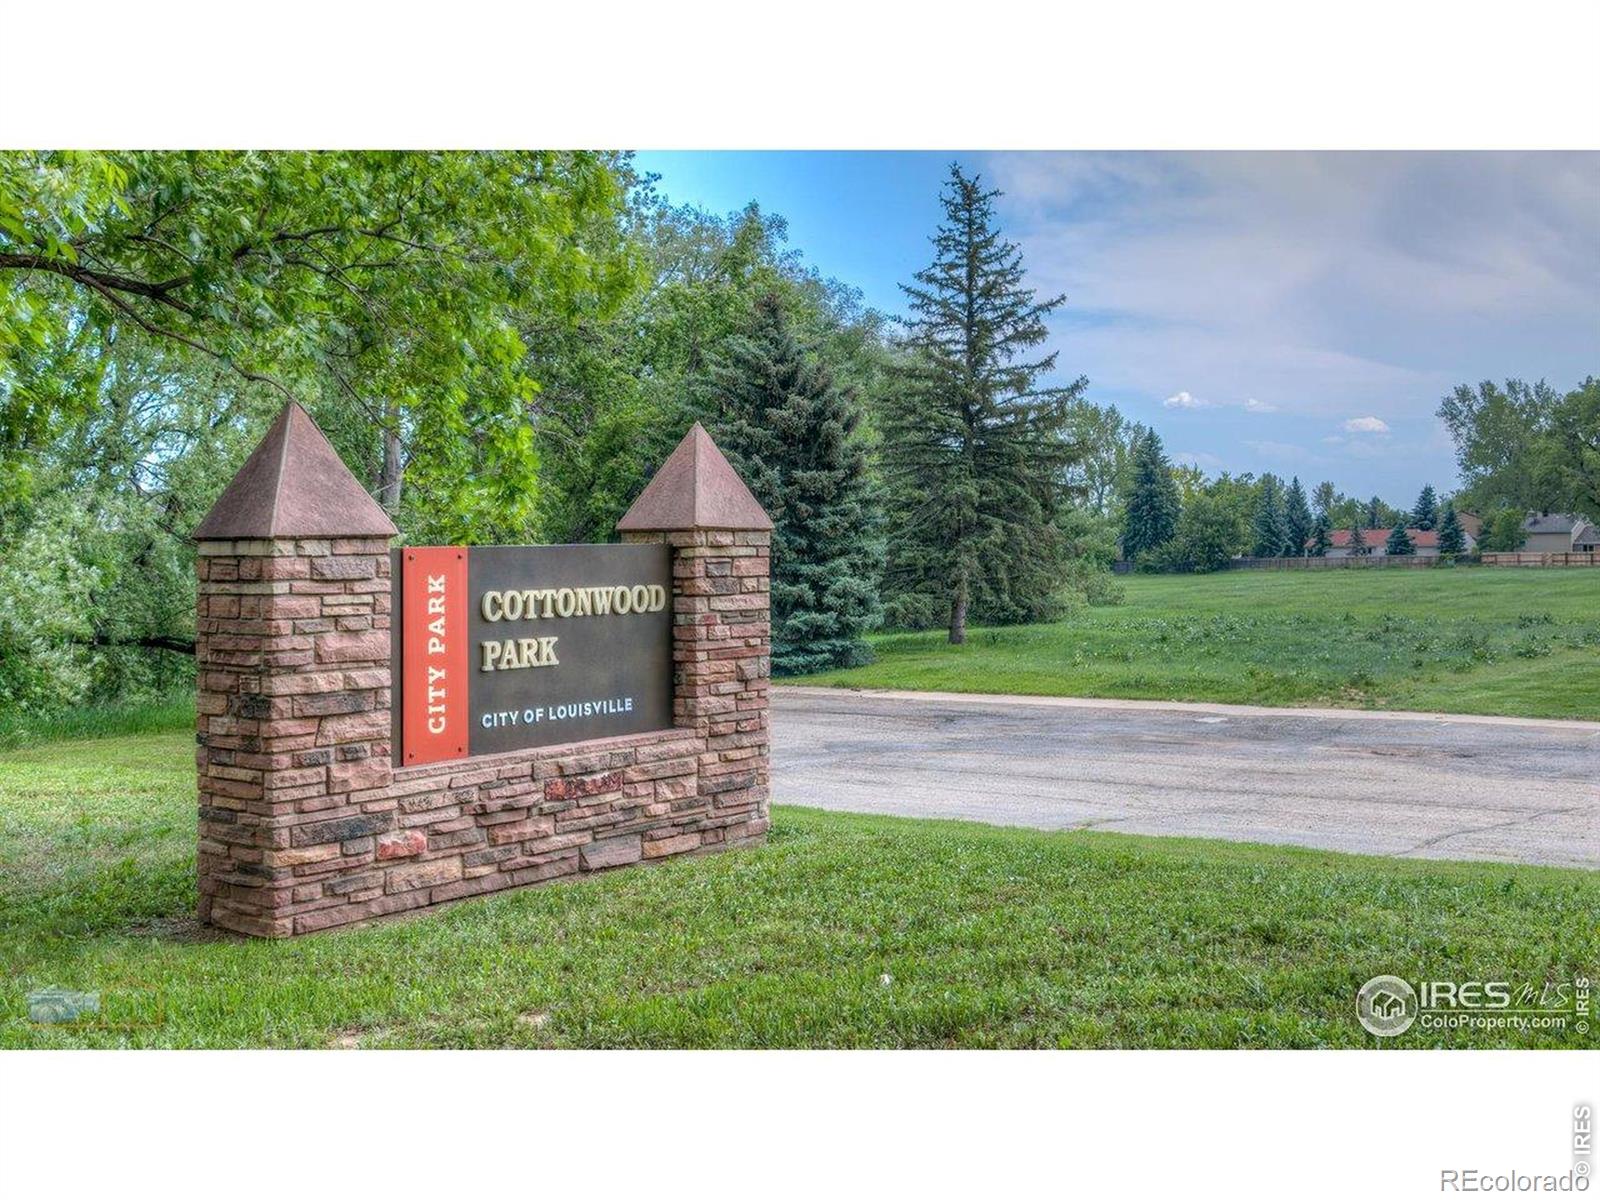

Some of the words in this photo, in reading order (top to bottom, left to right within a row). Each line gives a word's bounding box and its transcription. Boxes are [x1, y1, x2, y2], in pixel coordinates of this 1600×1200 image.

[428, 574, 446, 655] PARK
[481, 584, 667, 623] COTTONWOOD
[481, 636, 560, 672] PARK
[428, 666, 446, 734] CITY
[481, 711, 520, 729] CITY
[524, 708, 543, 724] OF
[549, 698, 633, 721] LOUISVILLE
